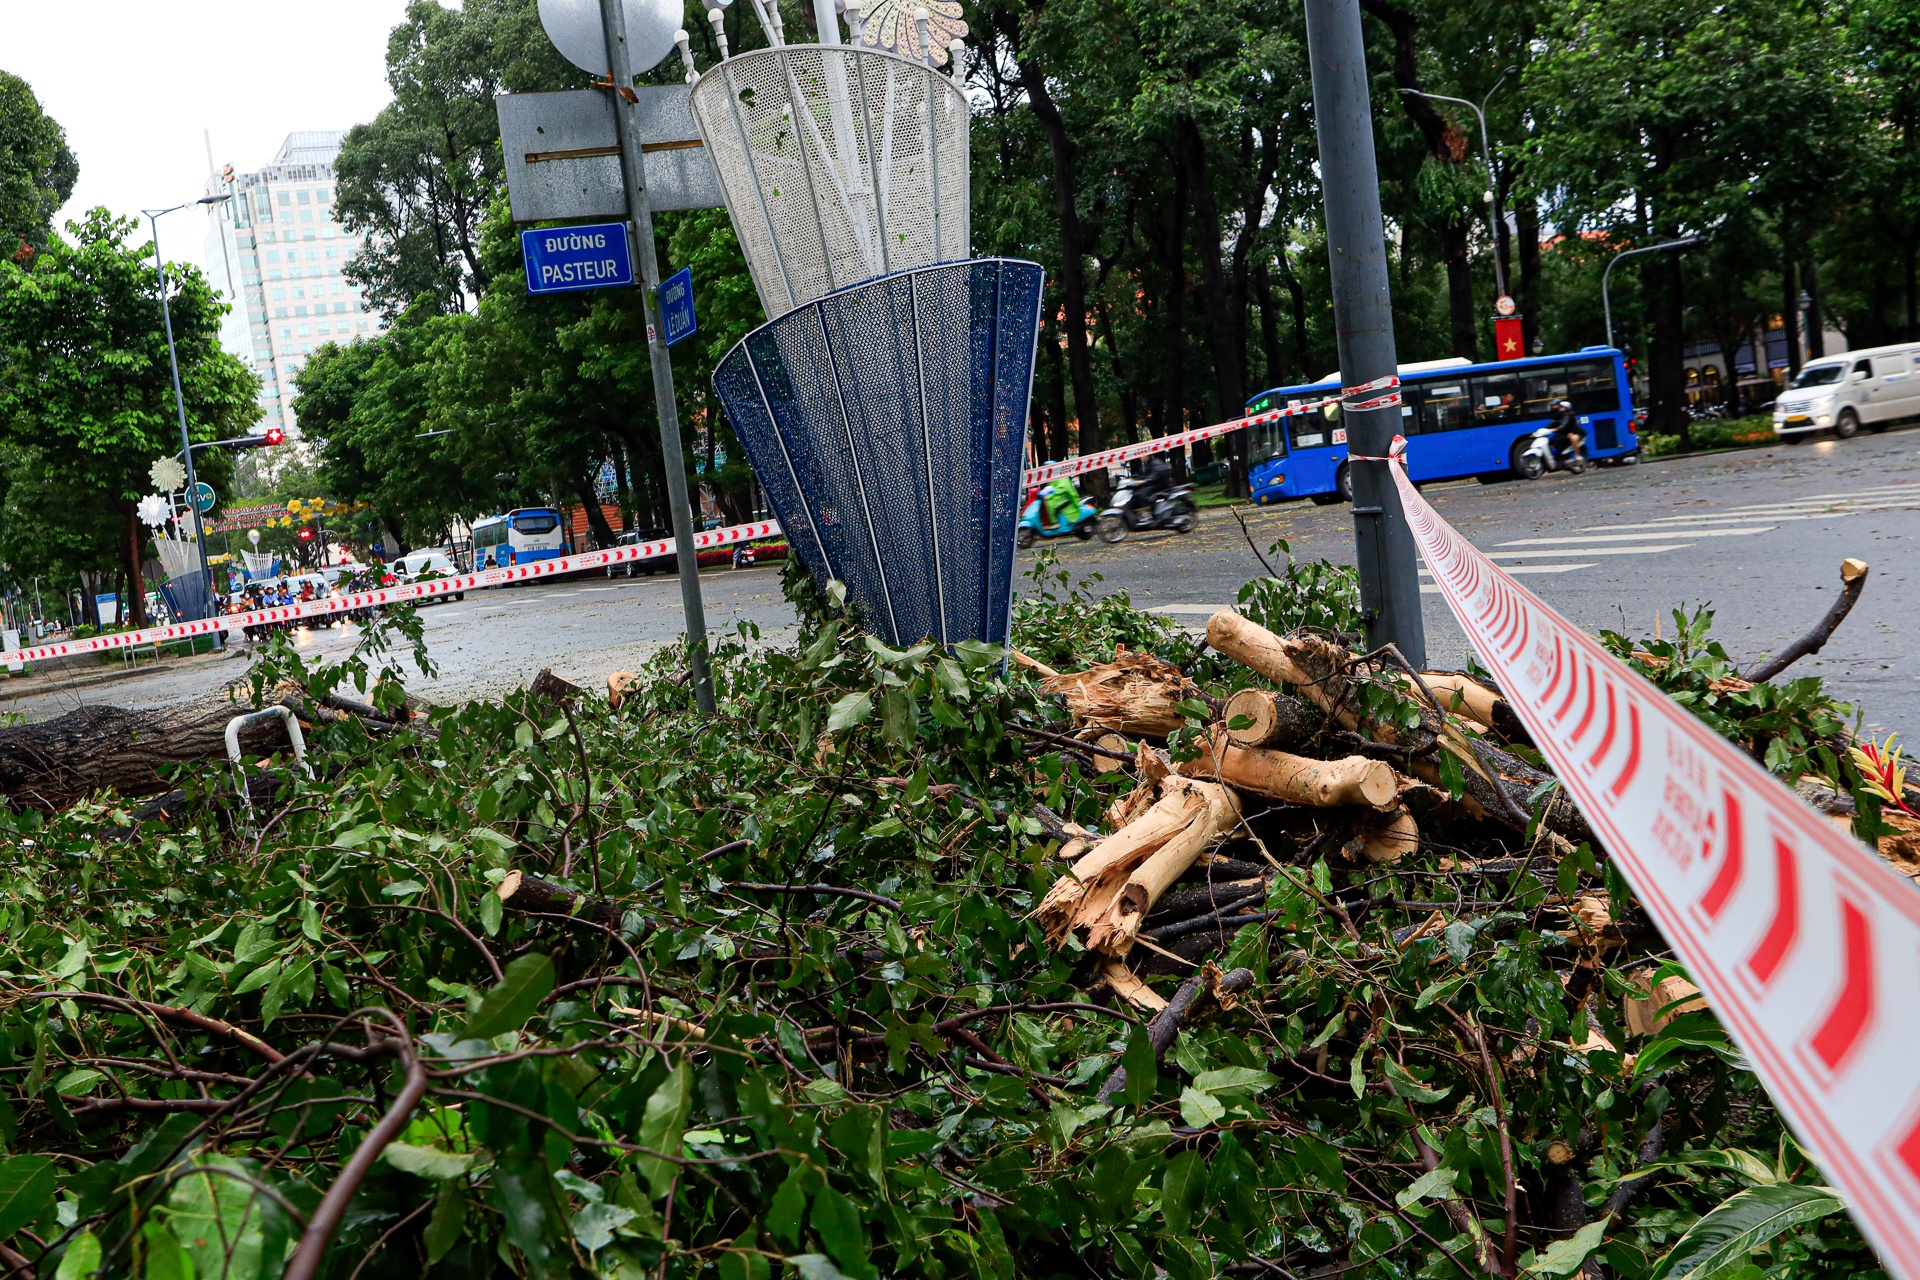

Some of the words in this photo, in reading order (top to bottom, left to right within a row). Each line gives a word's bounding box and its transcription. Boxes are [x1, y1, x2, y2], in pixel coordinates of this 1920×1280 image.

[545, 233, 606, 253] ĐƯỜNG
[542, 259, 618, 284] PASTEUR
[666, 281, 685, 305] ĐƯỜNG
[1333, 430, 1346, 442] 18
